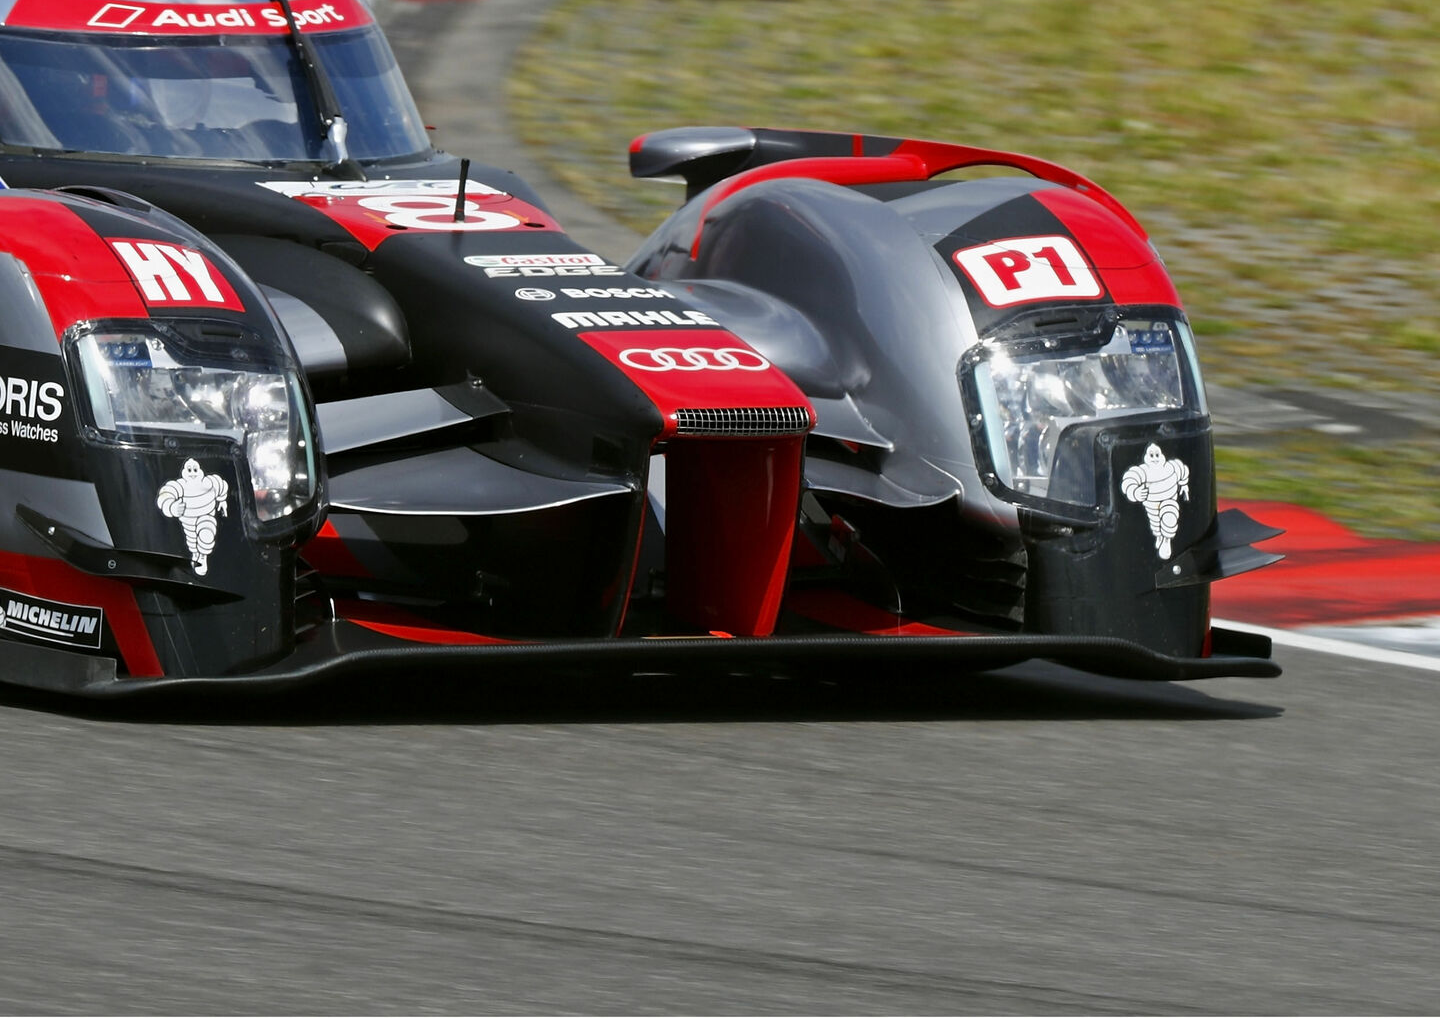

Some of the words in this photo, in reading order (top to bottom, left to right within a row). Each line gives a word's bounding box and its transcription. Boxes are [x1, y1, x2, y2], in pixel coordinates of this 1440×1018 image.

[152, 8, 257, 27] Audi
[358, 195, 521, 231] 8
[501, 255, 593, 265] Castrol
[982, 246, 1077, 291] P1
[112, 241, 225, 303] HY
[483, 265, 626, 279] EDGE
[560, 287, 677, 299] BOSCH
[551, 310, 720, 330] MAHLE
[10, 419, 59, 443] Watches
[6, 599, 98, 634] MICHELIN
